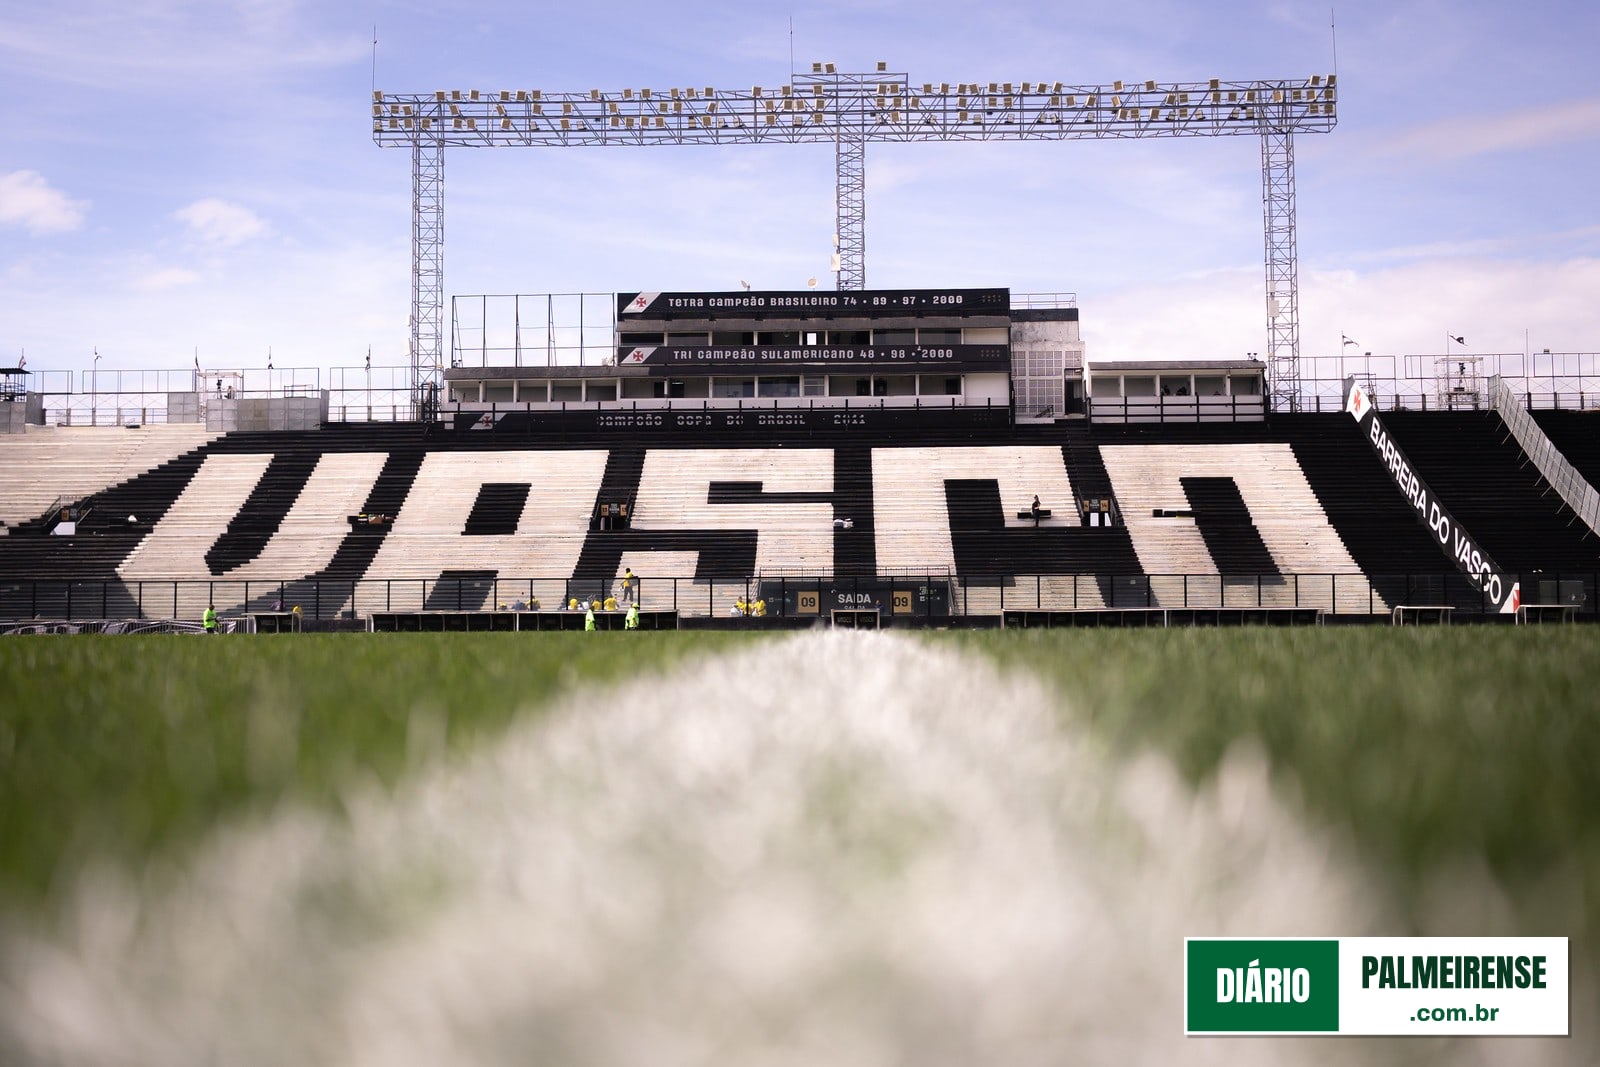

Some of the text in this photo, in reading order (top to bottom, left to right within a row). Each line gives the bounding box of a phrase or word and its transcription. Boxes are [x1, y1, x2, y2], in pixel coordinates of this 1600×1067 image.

[843, 297, 857, 305] 74
[873, 297, 887, 305] 89
[902, 296, 916, 305] 97
[933, 295, 963, 304] 2000
[673, 350, 692, 359] TRI
[860, 349, 875, 358] 48
[891, 349, 906, 358] 98
[922, 349, 953, 358] 2000
[1370, 417, 1502, 605] BARREIRA DO VASCO
[801, 597, 816, 607] 09
[893, 596, 909, 607] 09
